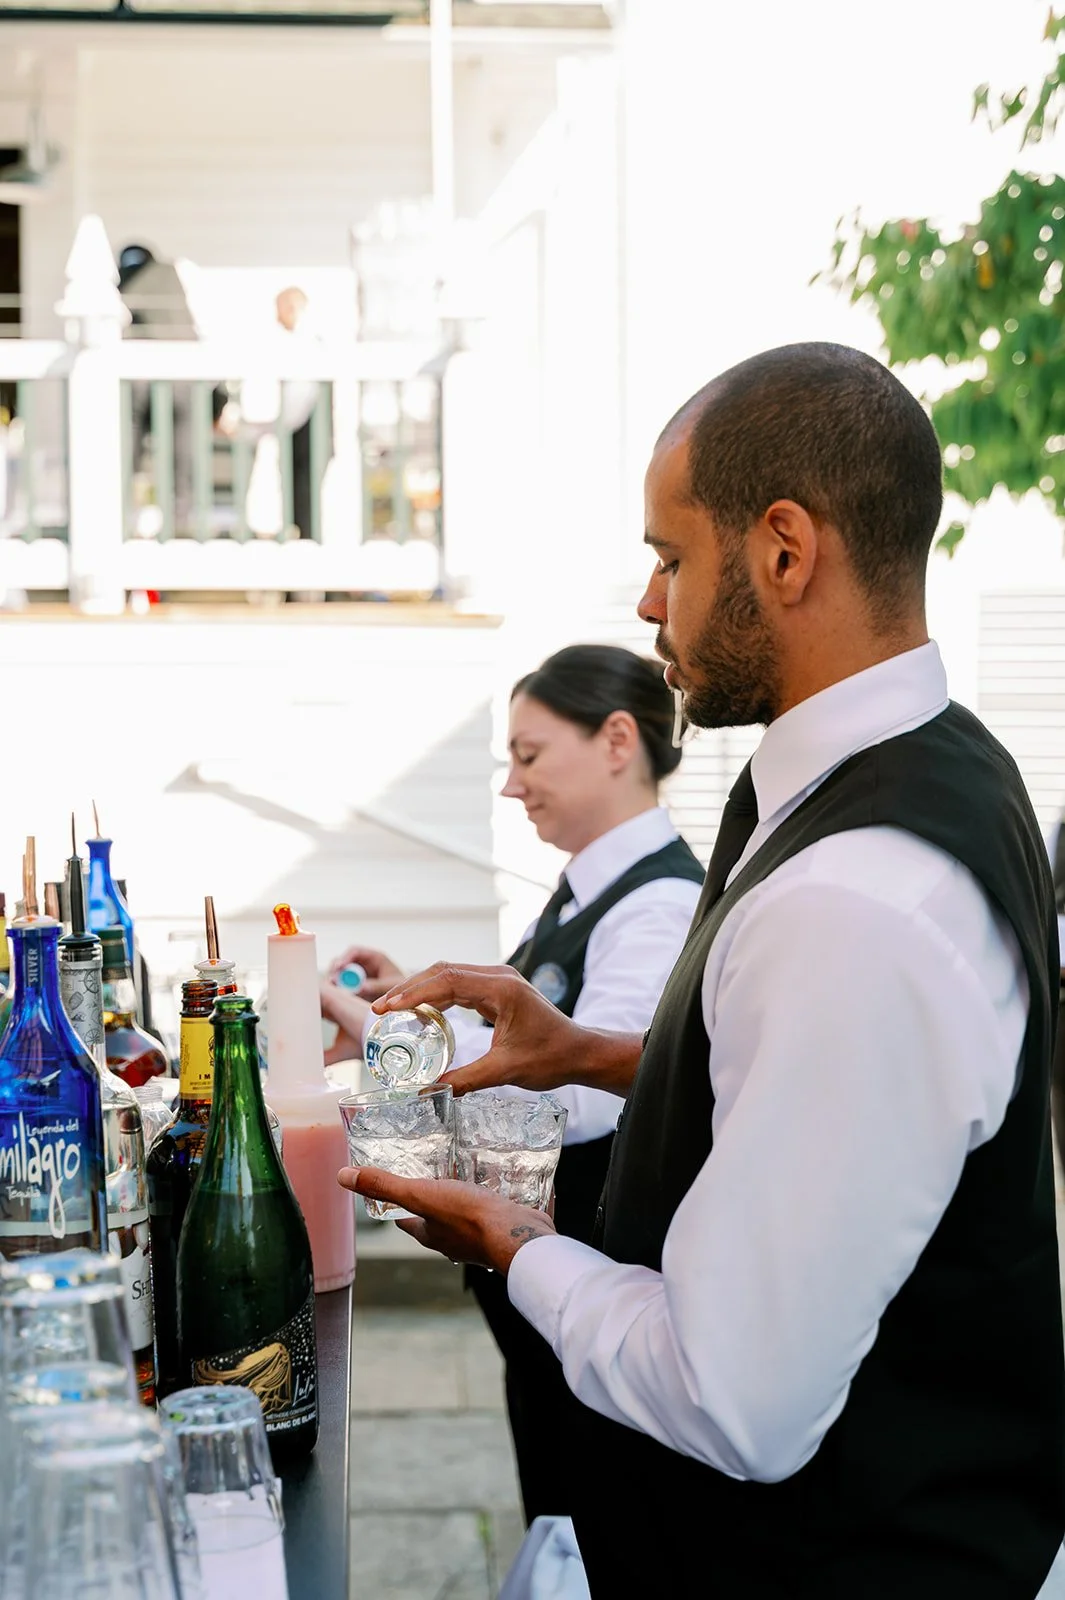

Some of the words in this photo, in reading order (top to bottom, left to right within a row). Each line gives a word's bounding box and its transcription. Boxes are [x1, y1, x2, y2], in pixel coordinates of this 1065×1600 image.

[28, 949, 38, 983] SILVER
[26, 1119, 64, 1140] Leyenda
[65, 1118, 79, 1132] del
[0, 1111, 81, 1239] milagro
[6, 1185, 41, 1207] Tequila
[266, 1420, 291, 1432] BLANC
[292, 1417, 301, 1427] DE
